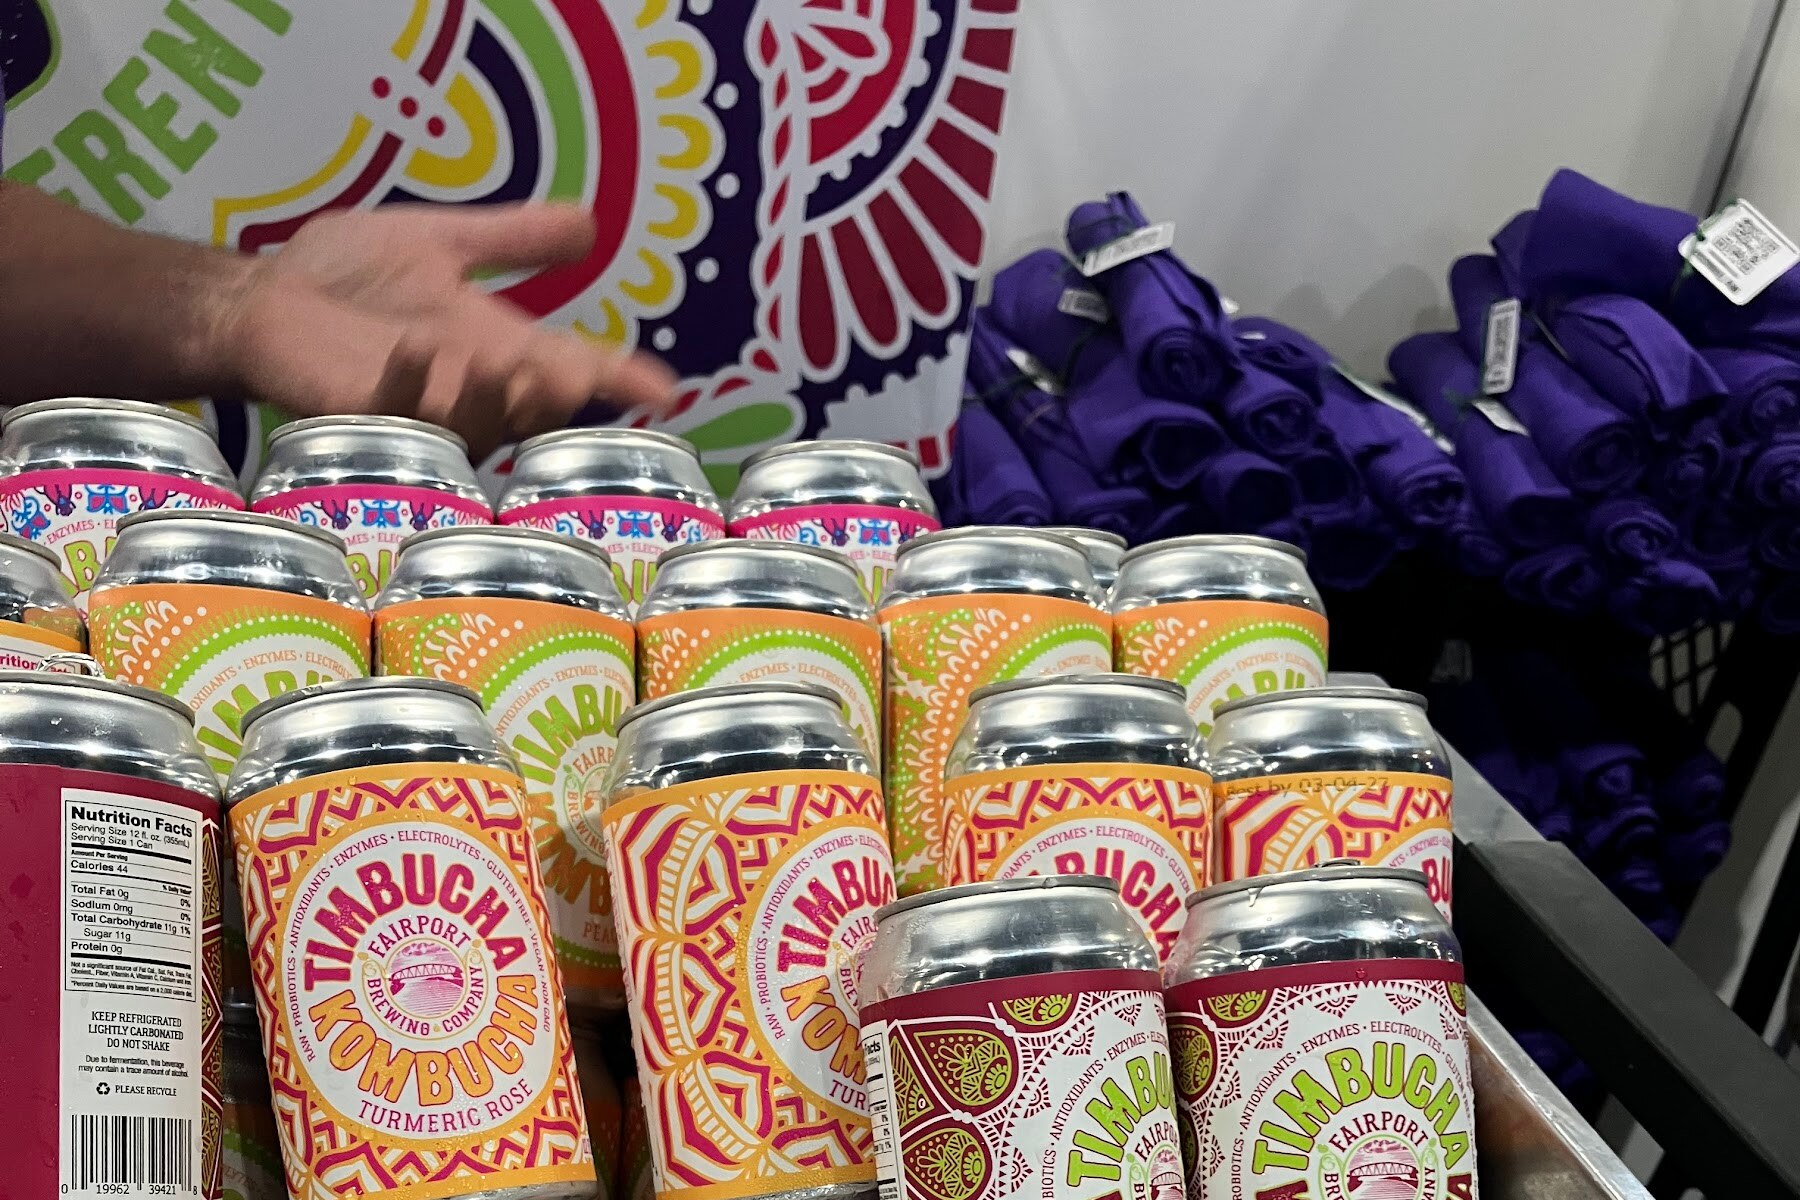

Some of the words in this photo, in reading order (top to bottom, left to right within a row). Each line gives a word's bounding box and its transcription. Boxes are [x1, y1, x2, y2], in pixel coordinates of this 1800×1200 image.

[47, 519, 94, 545] ENZYMES
[0, 654, 38, 671] rition
[189, 666, 237, 712] OXIDANTS
[244, 649, 297, 670] ENZYMES
[306, 652, 353, 680] ELECTROL
[739, 663, 790, 683] ENZYMES
[798, 663, 857, 701] ELECTROLYTES
[495, 678, 550, 736] NTIOXIDANTS
[555, 665, 597, 681] ENZYMES
[512, 684, 622, 785] IMBU
[573, 746, 615, 775] FAIRP
[1226, 784, 1260, 799] Best
[1268, 780, 1292, 797] by
[71, 806, 150, 828] Nutrition
[155, 818, 192, 838] Facts
[71, 823, 105, 834] Serving
[108, 826, 126, 836] Size
[71, 832, 105, 845] Serving
[108, 836, 126, 846] Size
[137, 840, 153, 849] Can
[107, 852, 128, 861] Serving
[333, 834, 388, 867] ENZYMES
[398, 830, 481, 860] ELECTROLYTES
[527, 791, 613, 917] KOMB
[813, 835, 854, 859] ENZYMES
[71, 860, 114, 871] Calories
[117, 865, 128, 873] 44
[1036, 827, 1087, 852] ENZYMES
[1096, 826, 1165, 858] ELECTROLYTES
[1168, 858, 1191, 894] GLUTEN
[486, 860, 516, 898] GLUTEN
[762, 858, 811, 929] ANTIOXIDANTS
[71, 884, 96, 894] Total
[100, 887, 115, 896] Fat
[117, 889, 129, 900] 0g
[180, 899, 191, 907] 0%
[71, 899, 110, 910] Sodium
[114, 903, 133, 915] 0mg
[180, 912, 191, 922] 0%
[289, 867, 330, 948] ANTIOXIDANTS
[515, 898, 531, 924] FREE
[1054, 847, 1182, 962] BUCHA
[71, 913, 96, 923] Total
[100, 915, 162, 930] Carbohydrate
[165, 924, 176, 935] 11g
[180, 926, 191, 935] 1%
[303, 852, 528, 993] TIMBUCHA
[776, 855, 894, 973] TIMBUC
[71, 941, 108, 952] Protein
[111, 945, 123, 955] 0g
[84, 928, 112, 939] Sugar
[116, 931, 131, 942] 11g
[367, 915, 472, 959] FAIRPORT
[841, 916, 877, 950] FAIR
[87, 962, 113, 970] significant
[530, 933, 544, 972] VEGAN
[755, 937, 769, 1004] PROBIOTICS
[287, 957, 302, 1027] PROBIOTICS
[367, 978, 430, 1036] BREWING
[442, 966, 484, 1033] COMPANY
[541, 981, 550, 1003] NON
[88, 1024, 128, 1035] LIGHTLY
[130, 1027, 184, 1040] CARBONATED
[91, 1011, 116, 1021] KEEP
[119, 1013, 182, 1027] REFRIGERATED
[765, 1013, 786, 1040] RAW
[107, 1038, 119, 1048] DO
[122, 1039, 141, 1049] NOT
[142, 1040, 170, 1051] SHAKE
[299, 1035, 316, 1062] RAW
[308, 974, 539, 1107] KOMBUCHA
[79, 1065, 93, 1073] may
[95, 1065, 118, 1073] contain
[126, 1066, 141, 1074] trace
[86, 1055, 99, 1063] Due
[110, 1056, 149, 1066] fermentation,
[1240, 1052, 1296, 1130] ANTIOXIDANTS
[1301, 1023, 1360, 1053] ENZYMES
[1370, 1021, 1442, 1053] ELECTROLYTES
[115, 1085, 145, 1094] PLEASE
[146, 1087, 177, 1096] RECYCLE
[1050, 1060, 1104, 1140] ANTIOXIDANTS
[1106, 1032, 1146, 1060] ENZYMES
[358, 1100, 481, 1133] TURMERIC
[485, 1078, 533, 1120] ROSE
[1066, 1051, 1172, 1187] TIMBU
[1251, 1040, 1470, 1175] TIMBUCHA
[1135, 1121, 1177, 1162] FAIRPO
[1328, 1111, 1429, 1153] FAIRPORT
[61, 1184, 68, 1194] 0
[96, 1184, 130, 1195] 19962
[149, 1185, 176, 1195] 39421
[193, 1185, 198, 1195] 8
